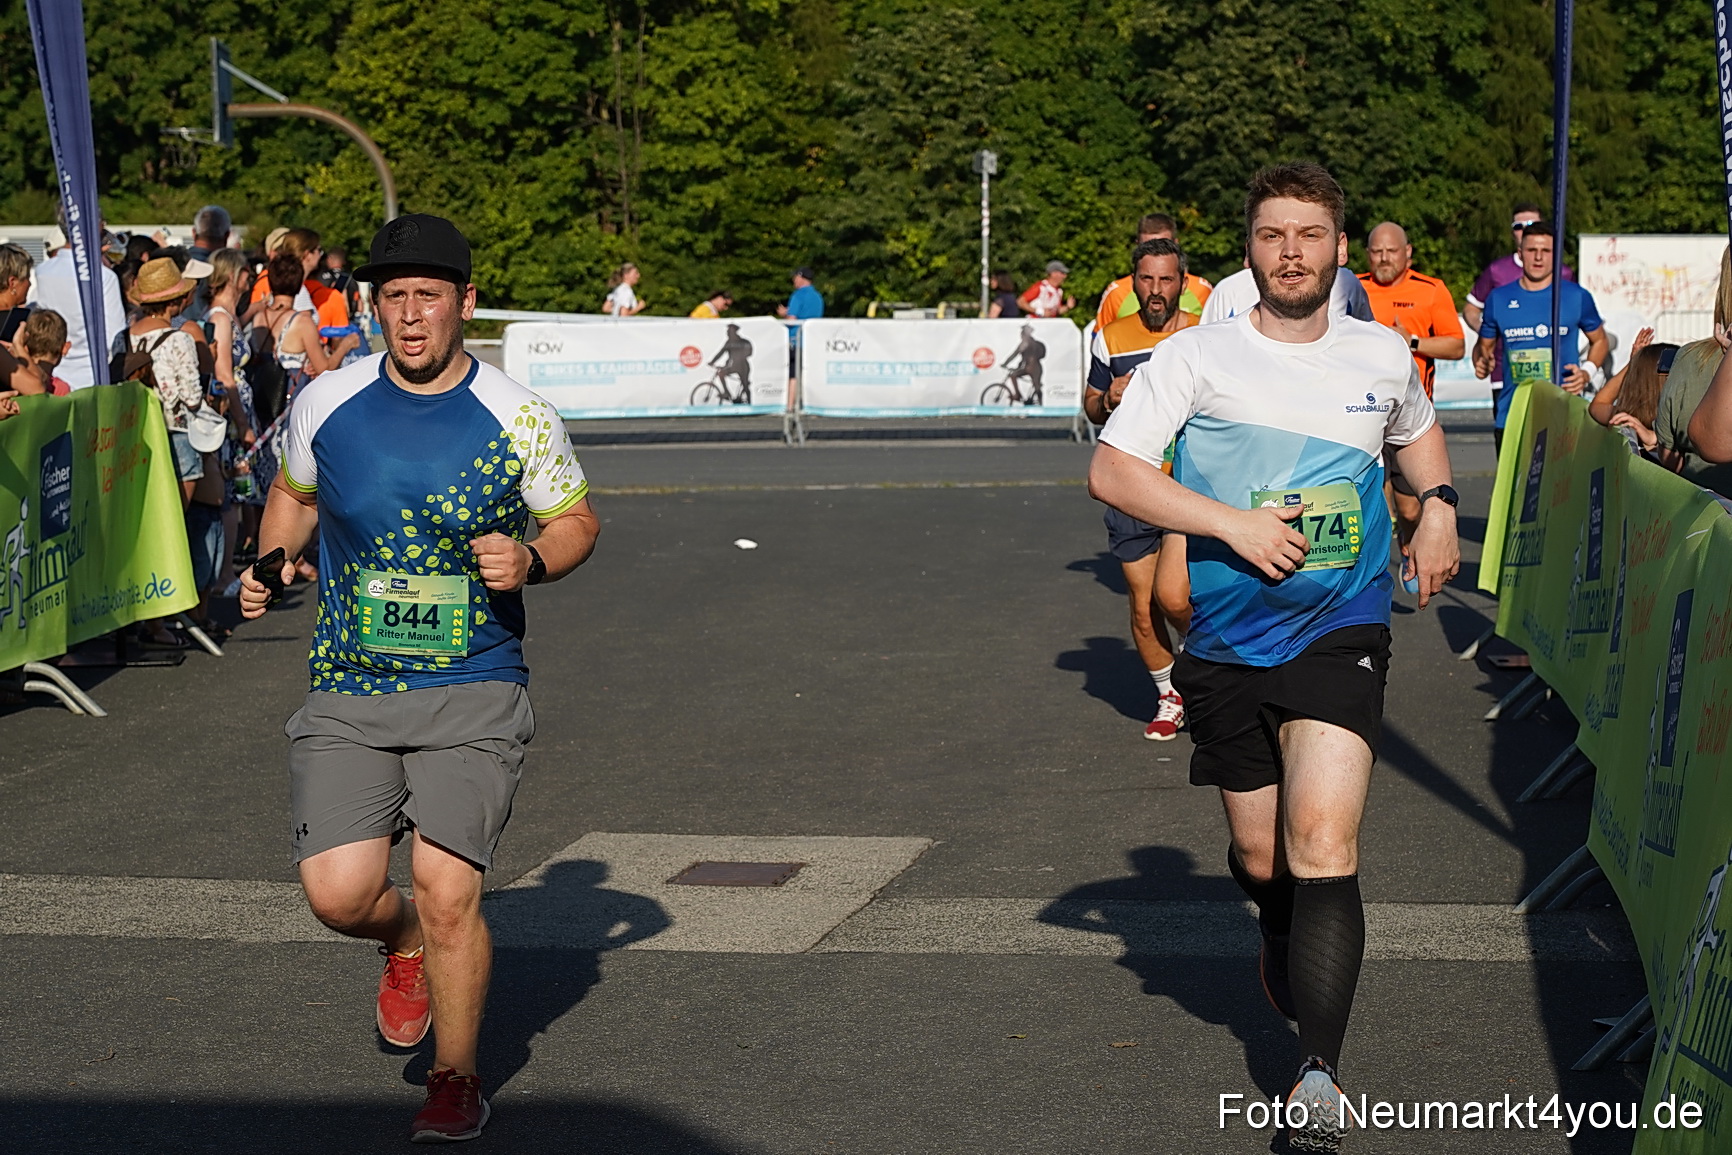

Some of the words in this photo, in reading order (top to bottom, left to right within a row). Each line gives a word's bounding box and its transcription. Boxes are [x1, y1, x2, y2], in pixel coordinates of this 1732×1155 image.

[1517, 362, 1540, 373] 734
[1348, 515, 1360, 554] 2022
[1308, 543, 1350, 554] hristoph
[386, 588, 420, 596] Firmenlauf
[362, 606, 372, 635] RUN
[383, 601, 441, 630] 844
[376, 628, 406, 640] Ritter
[407, 631, 445, 642] Manuel
[451, 609, 464, 646] 2022
